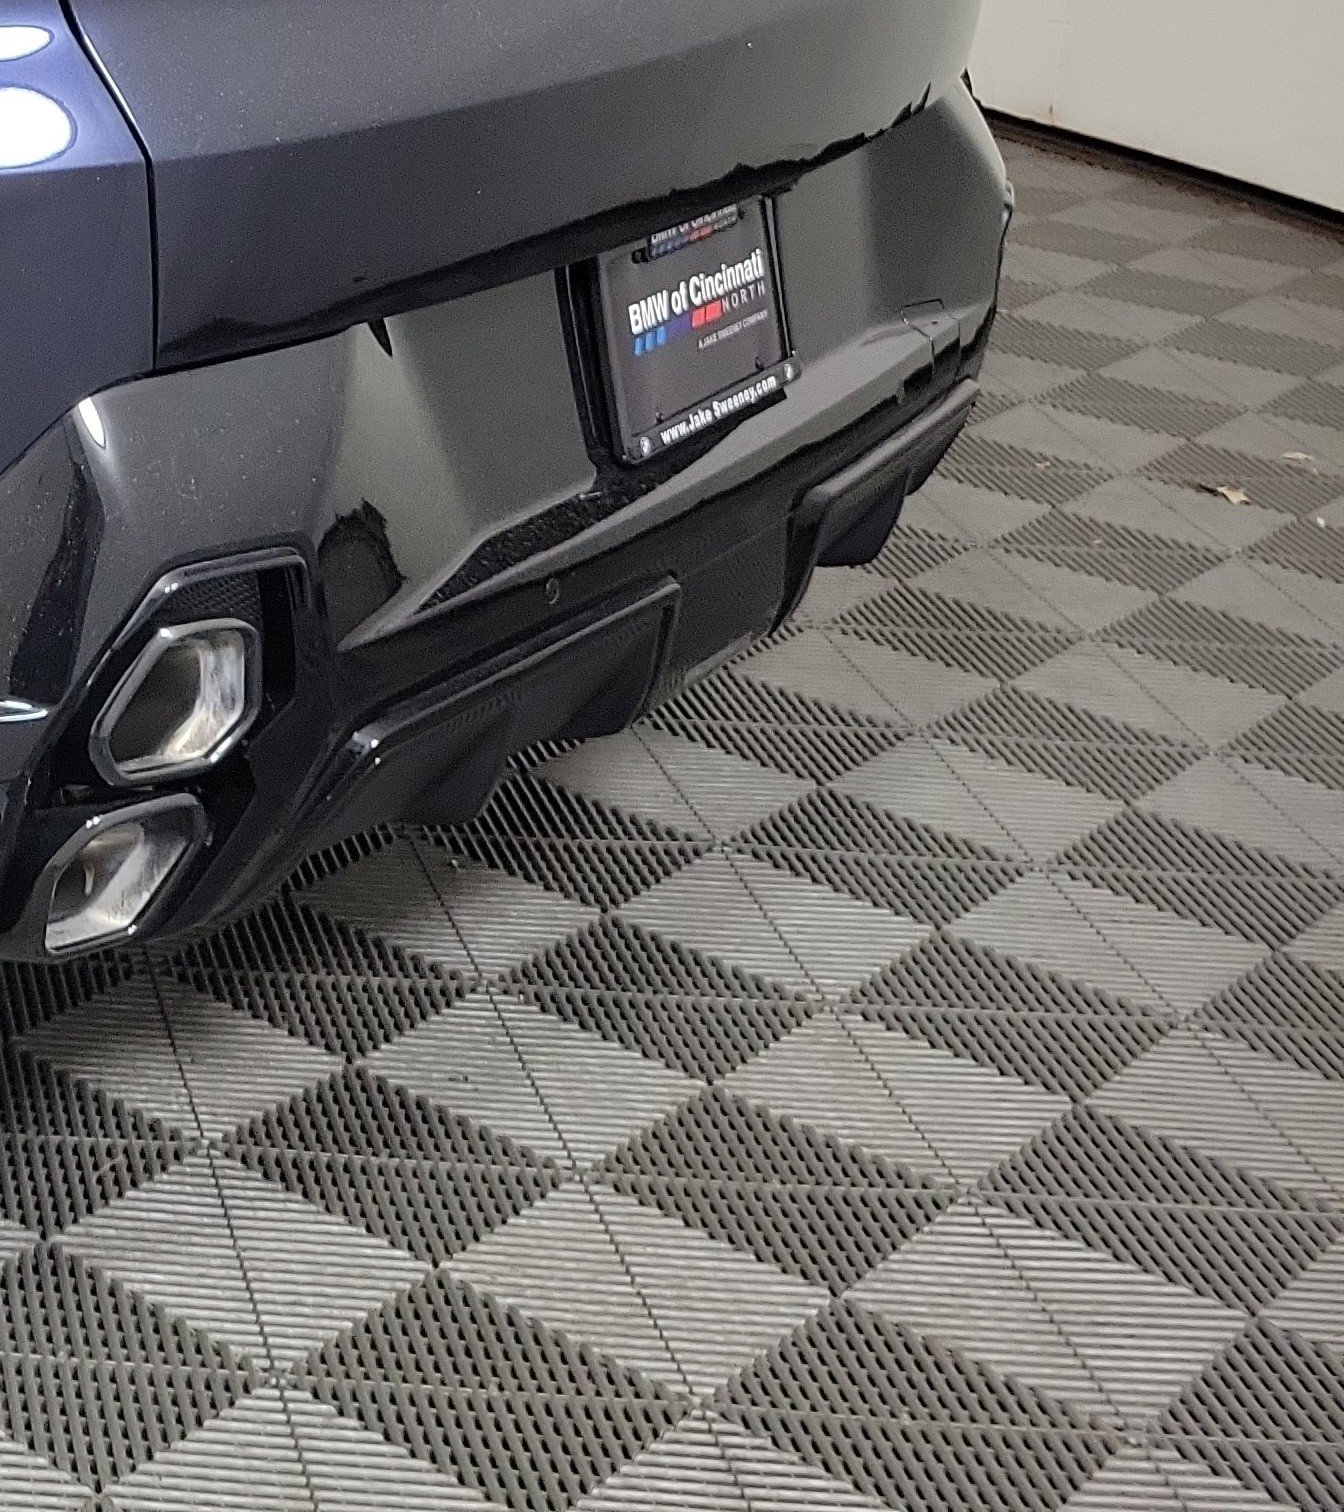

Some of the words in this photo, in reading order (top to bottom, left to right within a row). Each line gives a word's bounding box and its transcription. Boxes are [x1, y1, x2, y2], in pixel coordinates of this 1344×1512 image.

[628, 289, 670, 336] BMW
[671, 281, 688, 315] of
[689, 248, 765, 304] Cincinnati
[721, 283, 766, 313] NORTH
